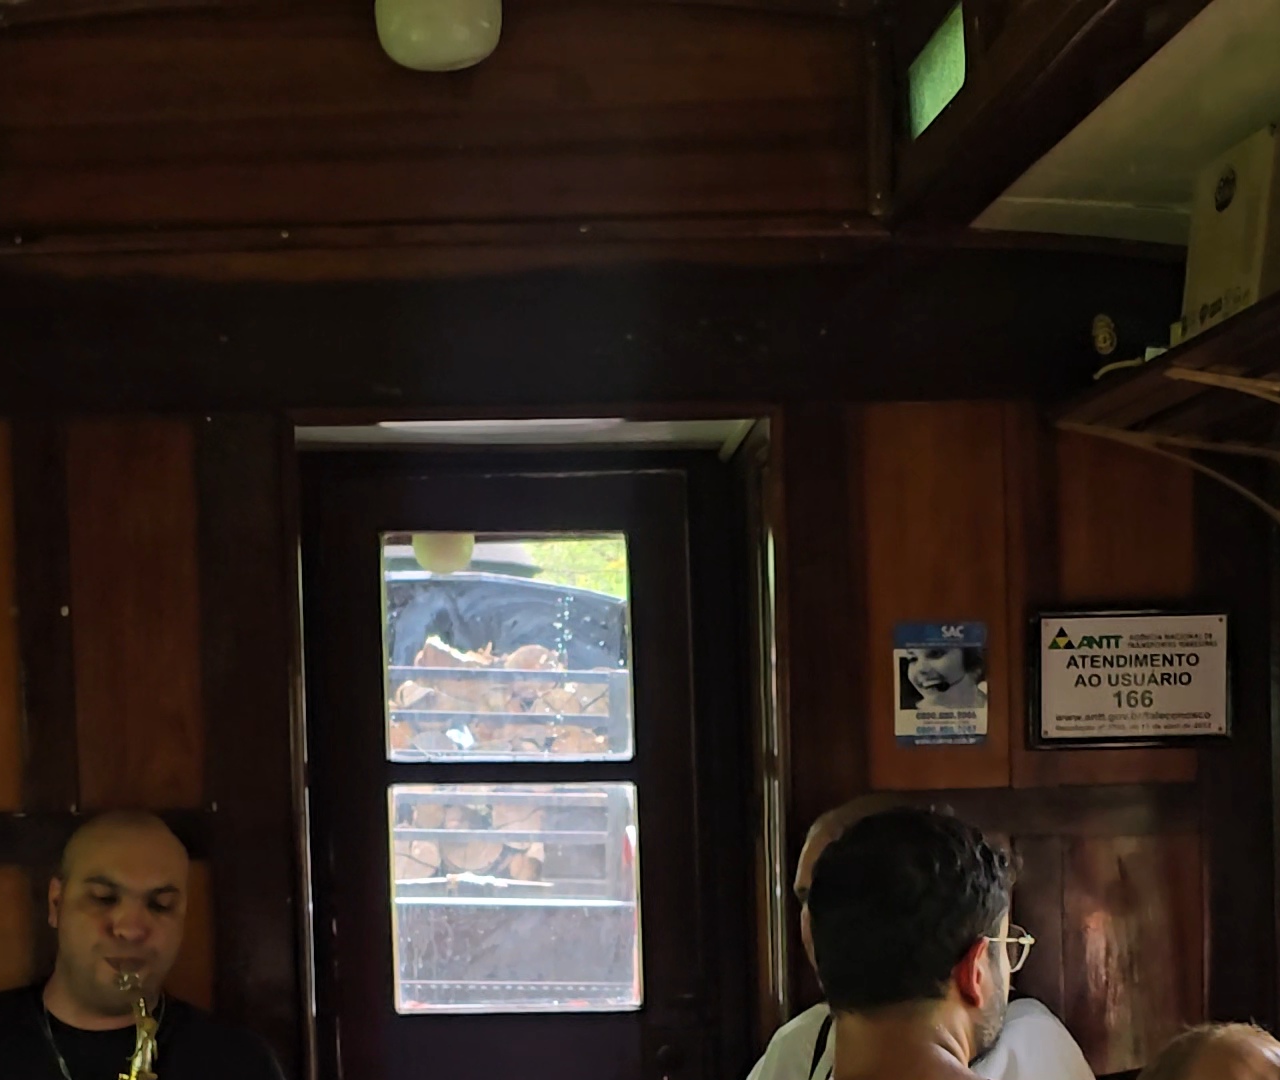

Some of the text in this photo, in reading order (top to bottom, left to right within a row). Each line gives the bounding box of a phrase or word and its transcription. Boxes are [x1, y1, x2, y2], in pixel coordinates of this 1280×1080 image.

[941, 625, 965, 638] SAC
[1077, 634, 1123, 649] ANTT
[1066, 653, 1200, 669] ATENDIMENTO
[1074, 670, 1193, 687] AO USUÁRIO
[1113, 690, 1154, 708] 166
